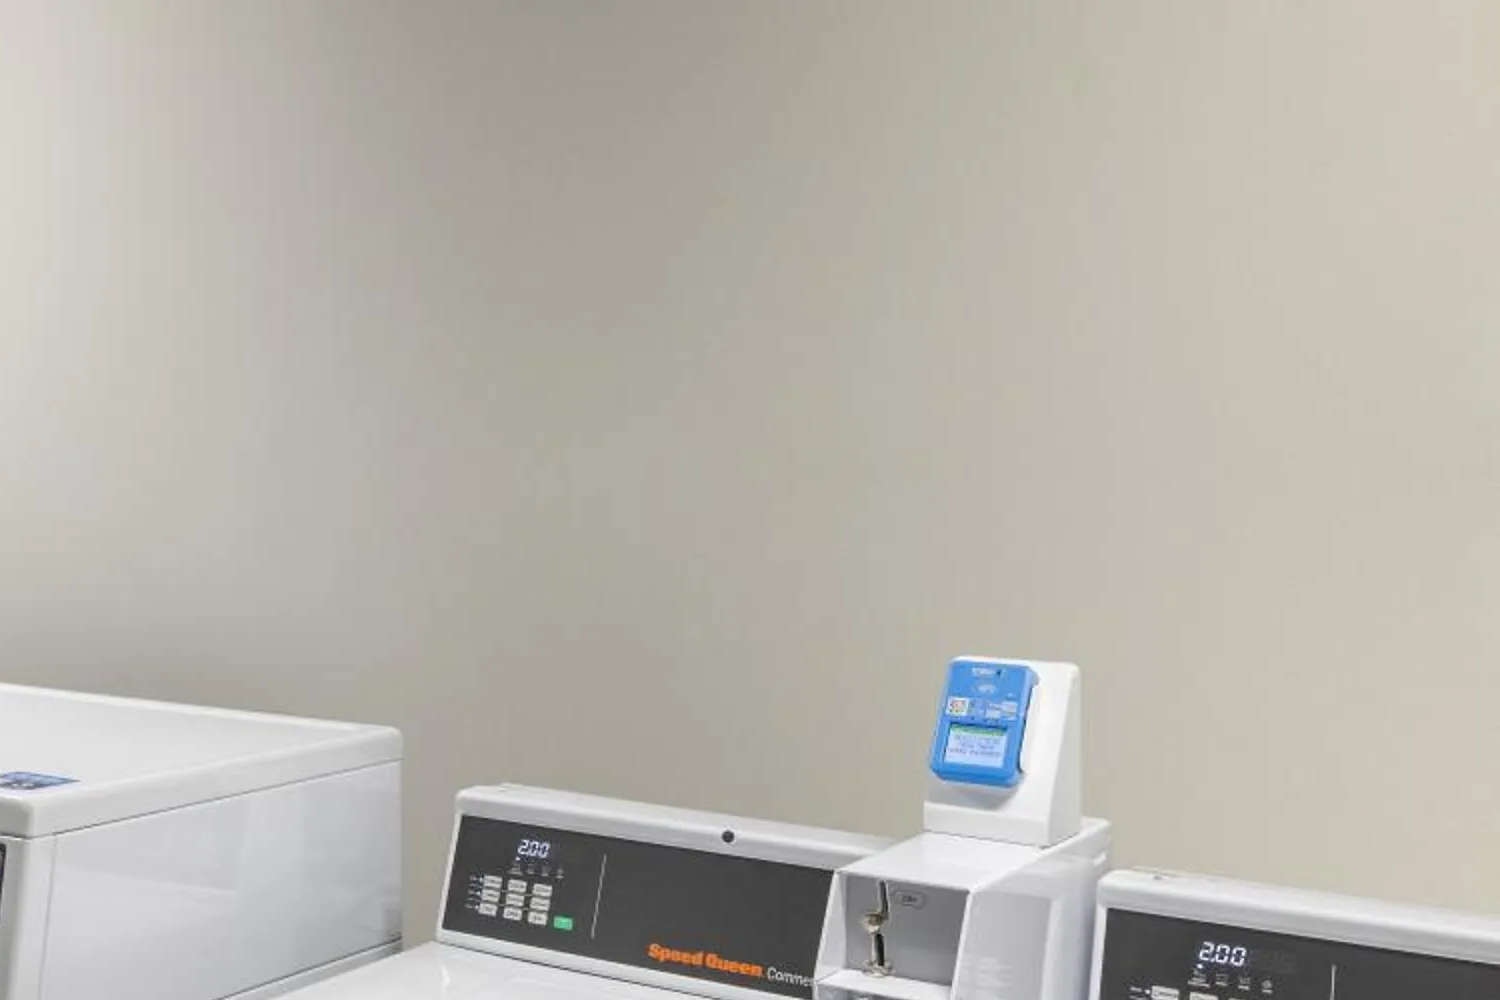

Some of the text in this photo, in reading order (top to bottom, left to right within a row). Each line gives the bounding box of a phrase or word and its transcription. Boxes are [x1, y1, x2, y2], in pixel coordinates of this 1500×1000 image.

[647, 943, 704, 967] Speed
[705, 953, 764, 977] Queen
[1199, 941, 1248, 967] 2.00
